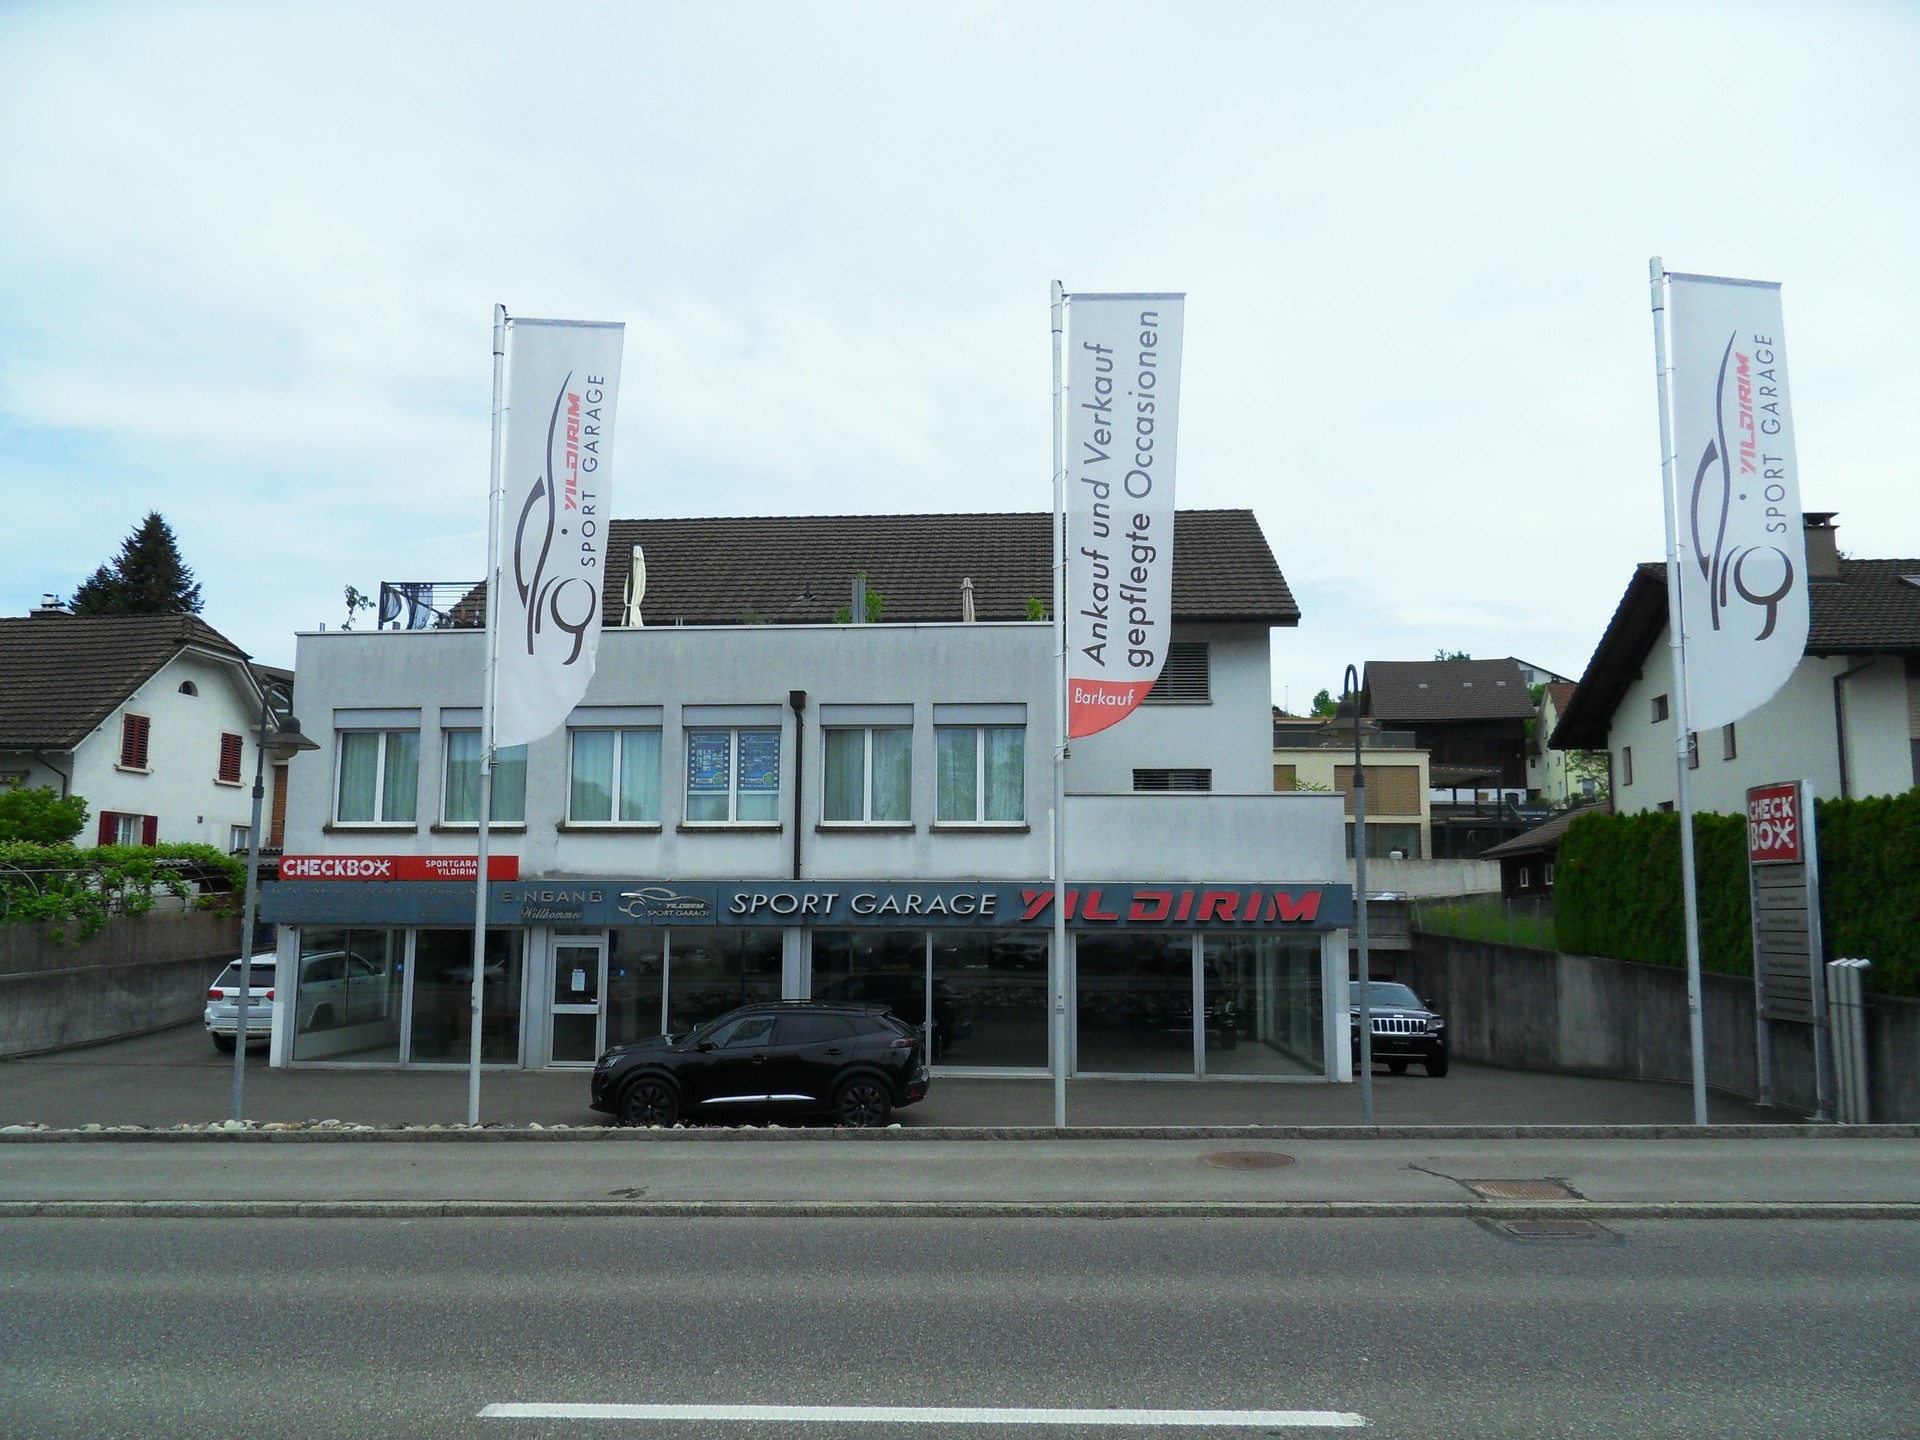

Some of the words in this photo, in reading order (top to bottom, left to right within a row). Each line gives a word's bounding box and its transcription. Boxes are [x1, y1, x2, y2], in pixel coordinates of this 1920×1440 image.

[582, 374, 605, 471] GARAGE
[1083, 342, 1115, 466] Verkauf
[1124, 311, 1160, 500] Occasionen
[1734, 352, 1758, 476] YILDIRIM
[1753, 334, 1782, 436] GARAGE
[564, 392, 582, 511] YILDIRIM
[581, 490, 597, 568] SPORT
[1081, 477, 1111, 538] und
[1762, 454, 1787, 534] SPORT
[1081, 547, 1110, 668] Ankauf
[1120, 513, 1157, 669] gepflegte
[1074, 687, 1136, 707] Barkauf
[1749, 795, 1794, 823] CHECK
[282, 859, 391, 876] CHECKBOX
[425, 860, 478, 868] SPORTGARA
[437, 868, 477, 876] YILDIRIM
[502, 890, 603, 903] EINGANG
[520, 906, 584, 919] Willkommen
[729, 892, 840, 916] SPORT
[850, 892, 997, 917] GARAGE
[1019, 889, 1323, 921] YILDIRIM
